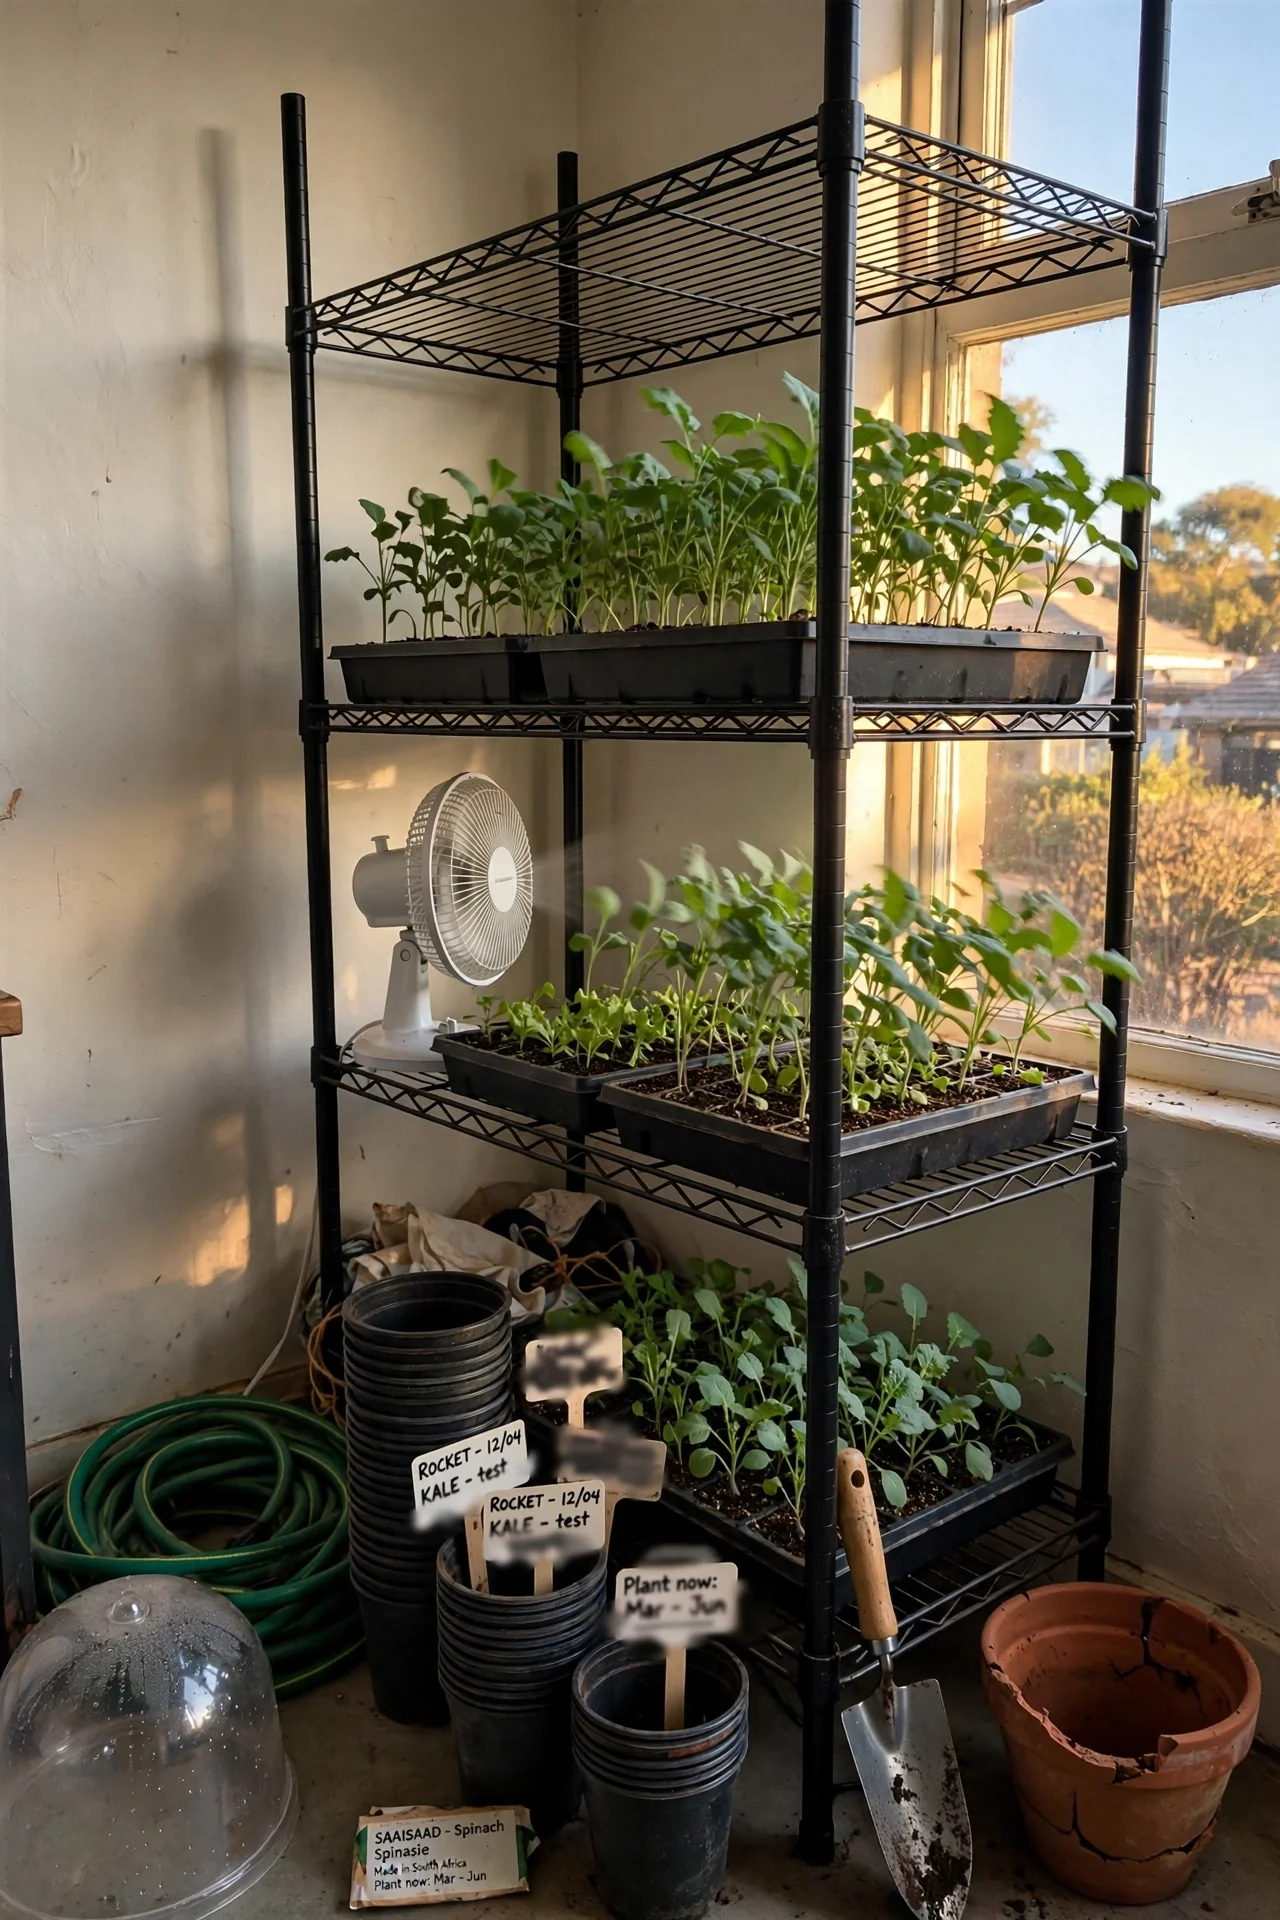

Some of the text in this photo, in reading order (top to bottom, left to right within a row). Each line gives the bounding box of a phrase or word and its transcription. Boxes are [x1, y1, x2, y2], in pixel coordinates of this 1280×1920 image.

[418, 1447, 471, 1480] ROCKET
[487, 1429, 522, 1454] 12/04
[420, 1477, 460, 1506] KALE
[477, 1458, 509, 1483] test
[490, 1493, 544, 1513] ROCKET
[561, 1486, 601, 1507] 12/04
[489, 1516, 534, 1538] KALE
[555, 1511, 590, 1529] test
[624, 1575, 718, 1595] Plant now:
[625, 1598, 664, 1618] Mar
[689, 1594, 727, 1616] Jun
[375, 1826, 441, 1844] SAAISAAD
[454, 1820, 505, 1838] Spinach
[374, 1844, 430, 1863] Spinasie
[402, 1863, 410, 1874] in
[440, 1859, 467, 1870] Africa
[374, 1879, 402, 1891] Plant
[406, 1877, 431, 1888] now:
[434, 1874, 455, 1885] Mar
[466, 1871, 487, 1882] Jun
